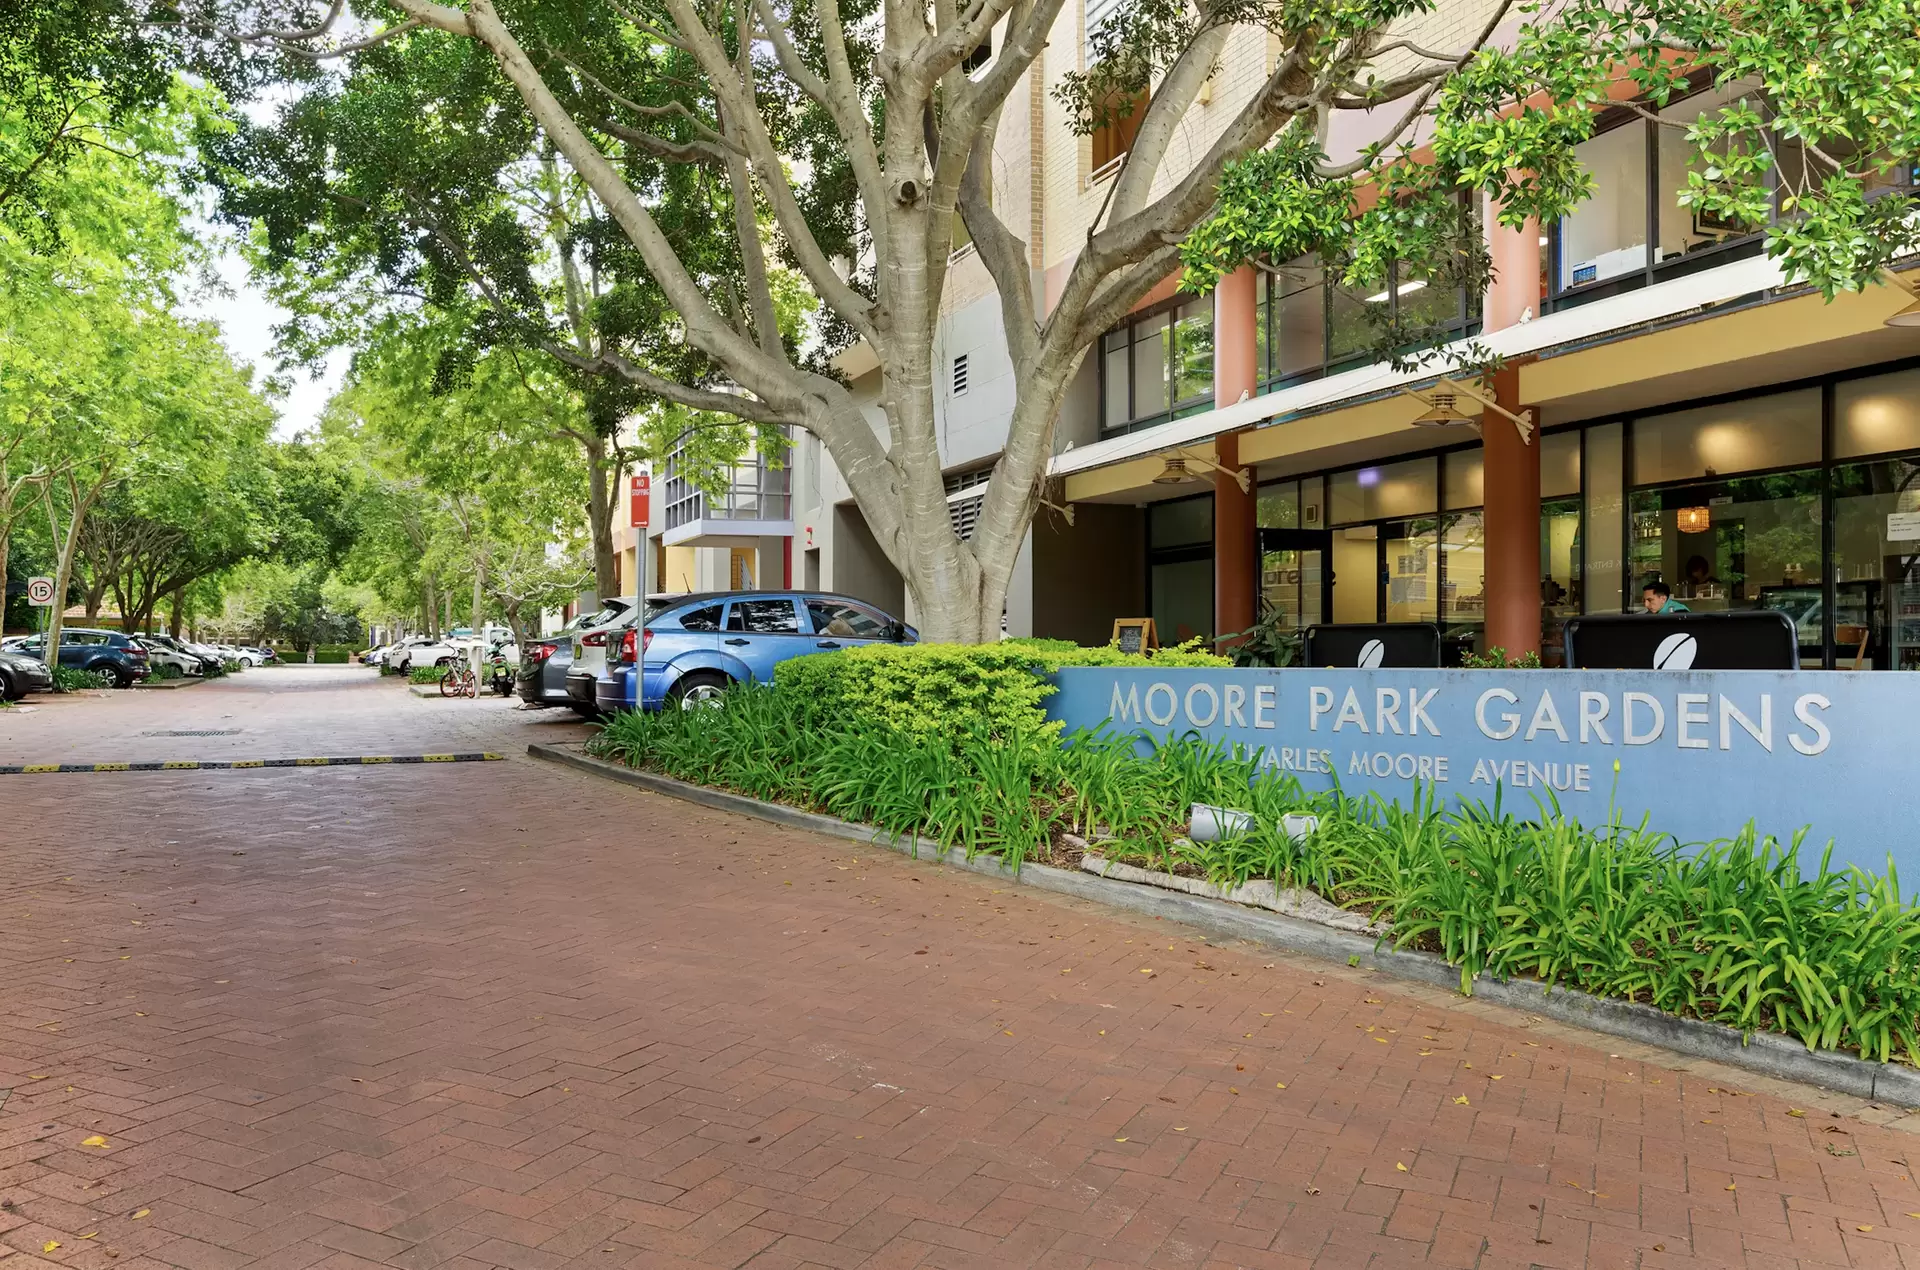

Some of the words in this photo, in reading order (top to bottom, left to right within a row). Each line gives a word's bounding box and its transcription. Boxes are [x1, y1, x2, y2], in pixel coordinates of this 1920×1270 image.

[636, 479, 644, 487] NO
[35, 586, 47, 596] 15
[1108, 681, 1277, 729] MOORE
[1309, 685, 1441, 736] PARK
[1474, 687, 1832, 756] GARDENS
[1348, 750, 1449, 782] MOORE
[1468, 757, 1591, 791] AVENUE
